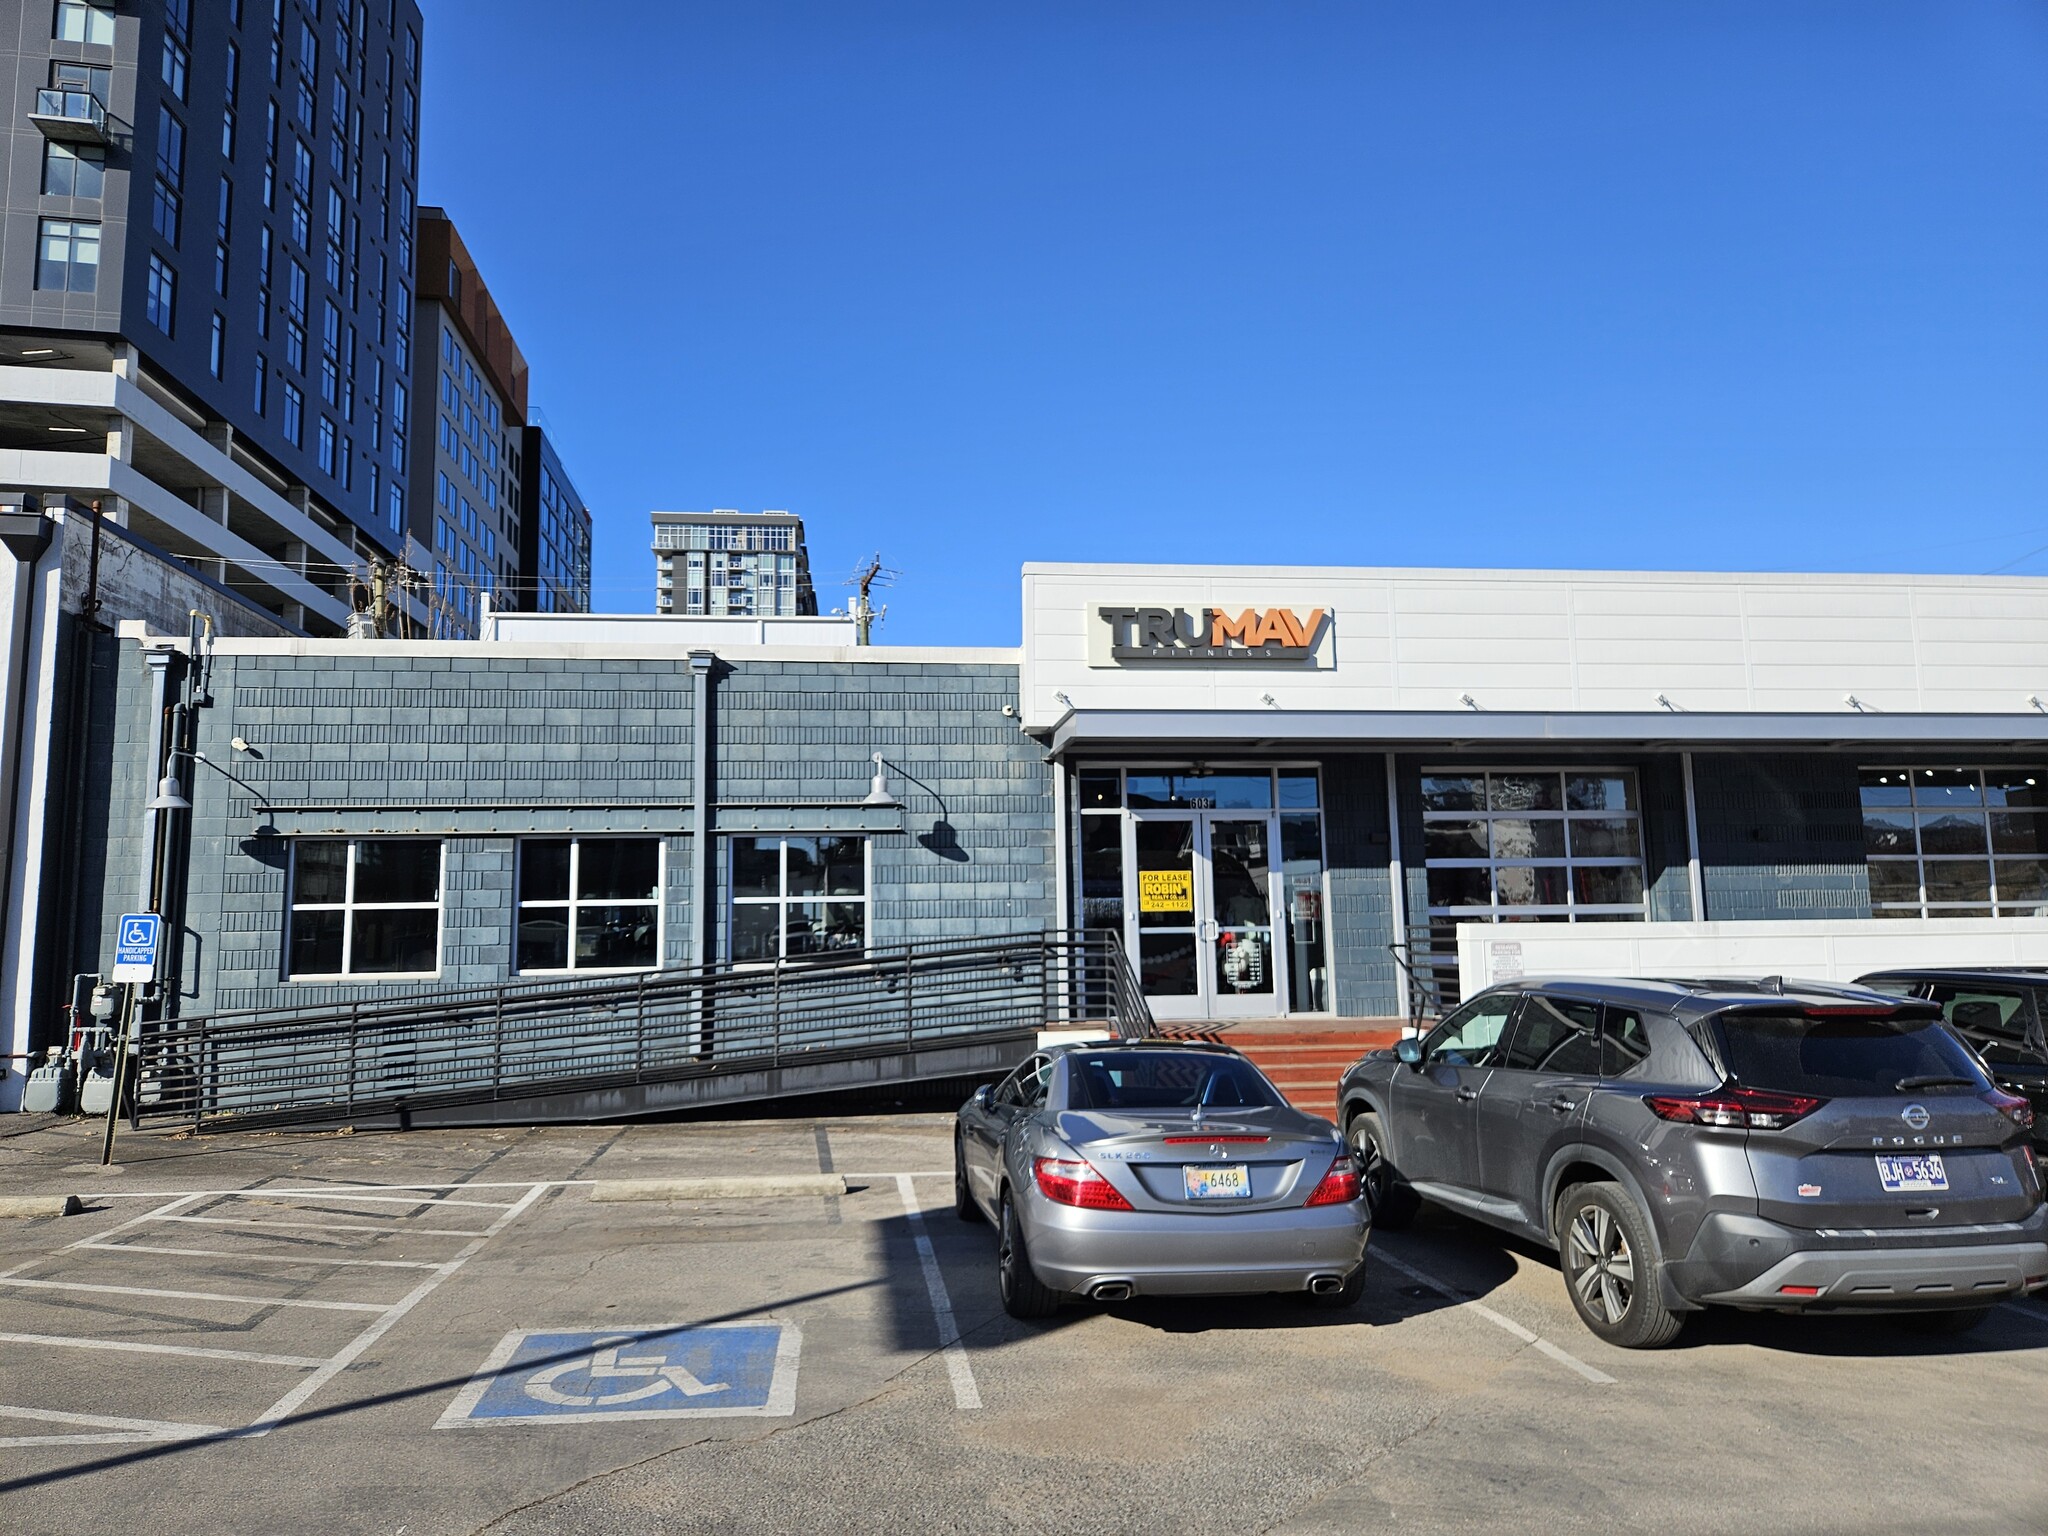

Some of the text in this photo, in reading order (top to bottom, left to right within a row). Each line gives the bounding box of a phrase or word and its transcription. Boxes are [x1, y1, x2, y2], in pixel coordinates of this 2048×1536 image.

[1099, 607, 1325, 647] TRUMAV
[1152, 649, 1271, 657] FITNESS
[1191, 797, 1209, 809] 603
[1161, 873, 1188, 881] LEASE
[1145, 883, 1182, 894] ROBIN
[1872, 1135, 1963, 1146] ROGUE
[1881, 1160, 1943, 1181] BJH 5636
[1211, 1172, 1239, 1187] 6468
